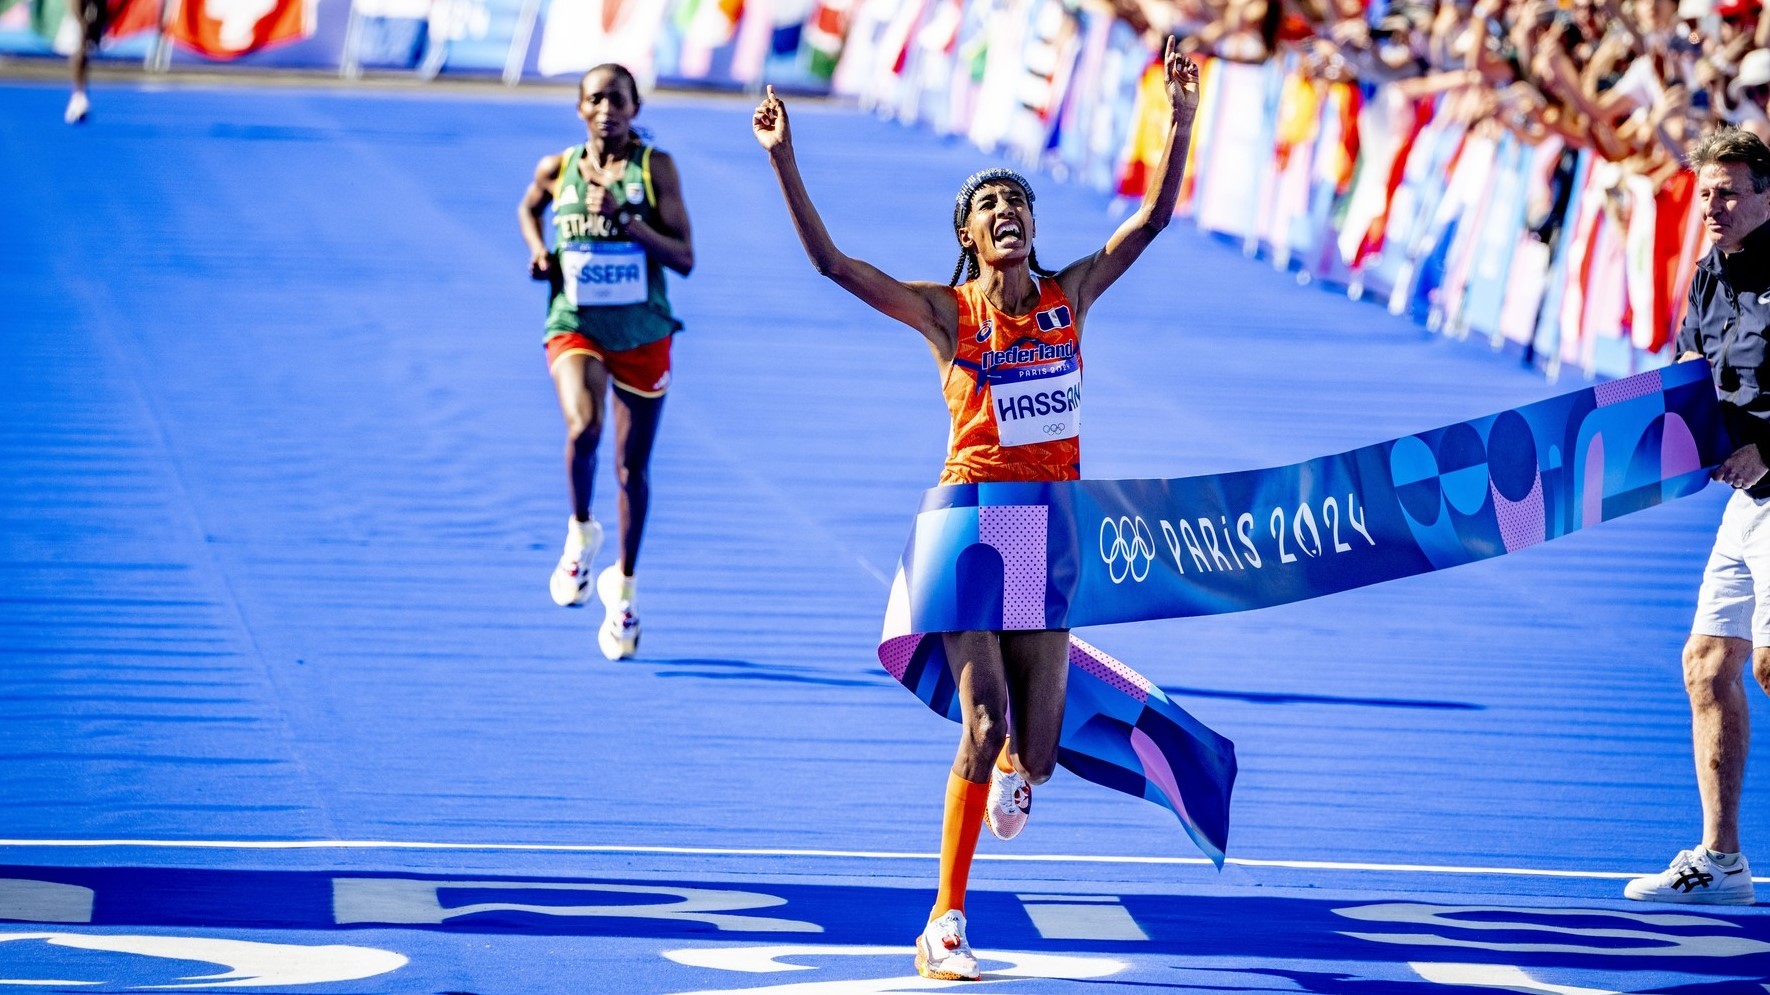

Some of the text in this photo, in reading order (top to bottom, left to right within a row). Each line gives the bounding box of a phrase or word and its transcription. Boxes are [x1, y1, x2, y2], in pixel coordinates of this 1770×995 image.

[561, 213, 618, 239] ETHIO
[982, 339, 1074, 371] nederland
[1019, 368, 1047, 378] PARIS
[997, 381, 1081, 422] HASSAN
[1270, 493, 1375, 564] 2024
